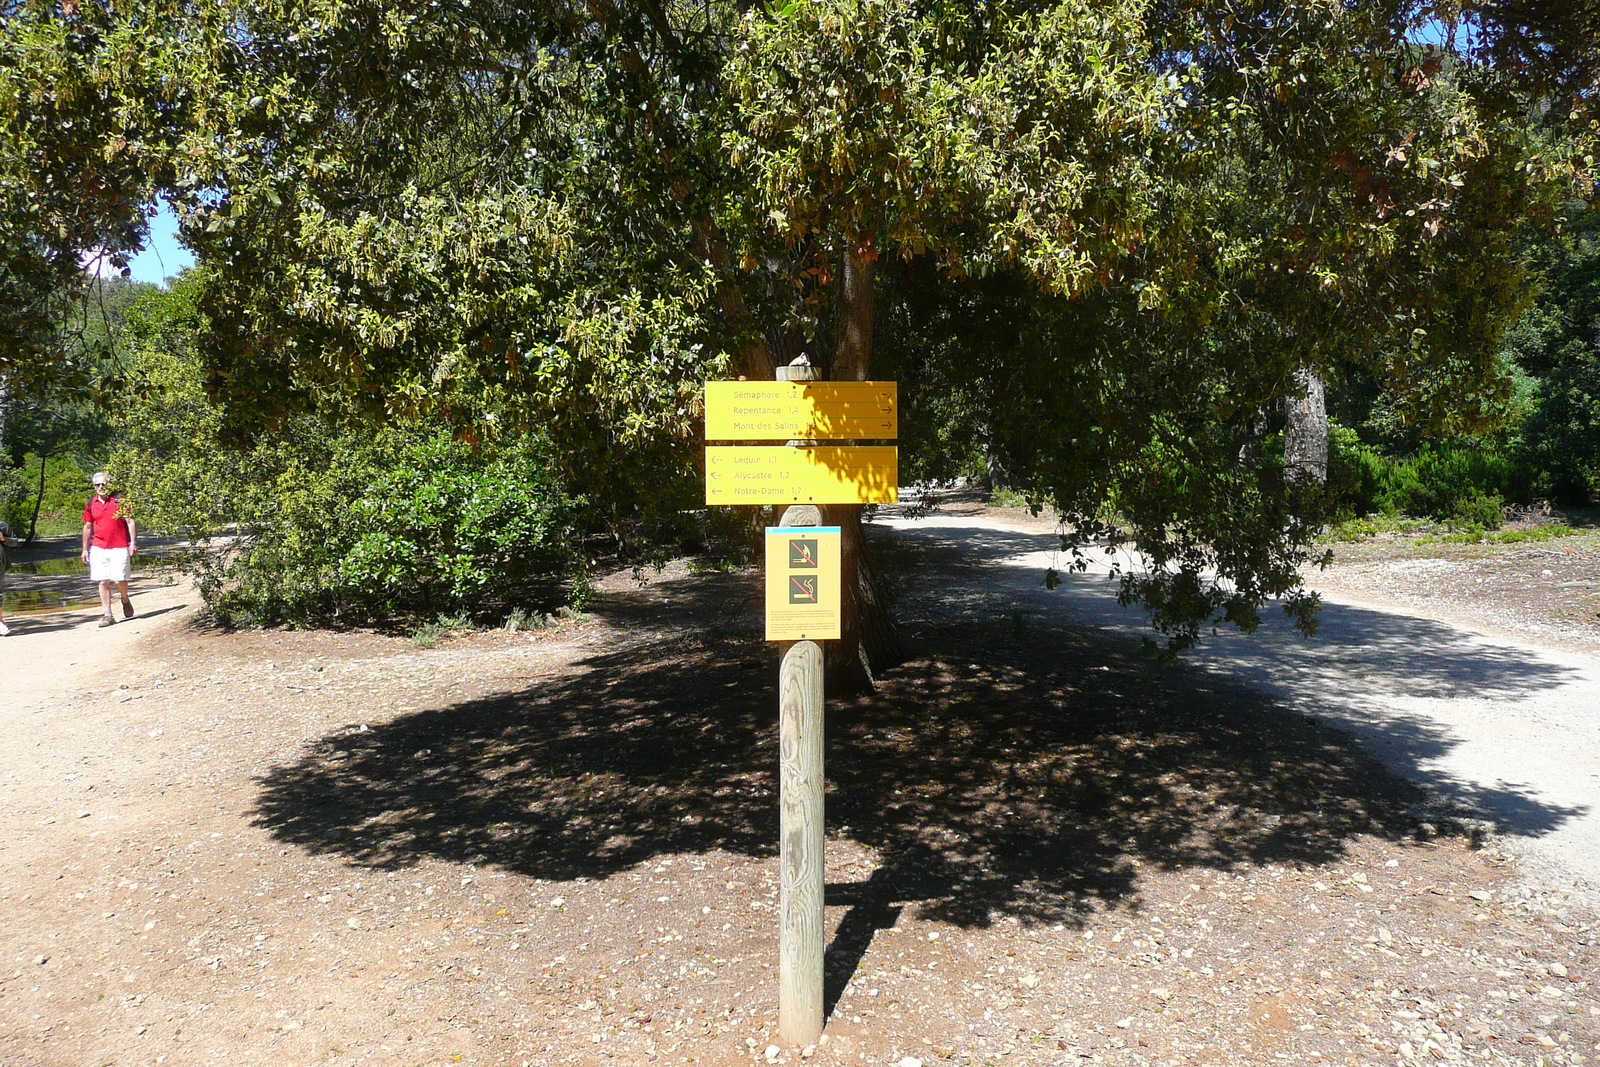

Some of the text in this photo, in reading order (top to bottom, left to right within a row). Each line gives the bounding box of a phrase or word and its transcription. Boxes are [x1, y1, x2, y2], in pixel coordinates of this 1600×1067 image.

[733, 406, 782, 415] Repentance
[733, 422, 754, 430] Mont
[757, 422, 772, 430] des
[774, 422, 799, 430] Salins
[734, 471, 773, 481] Alycastre
[734, 487, 785, 495] Notre-Dame
